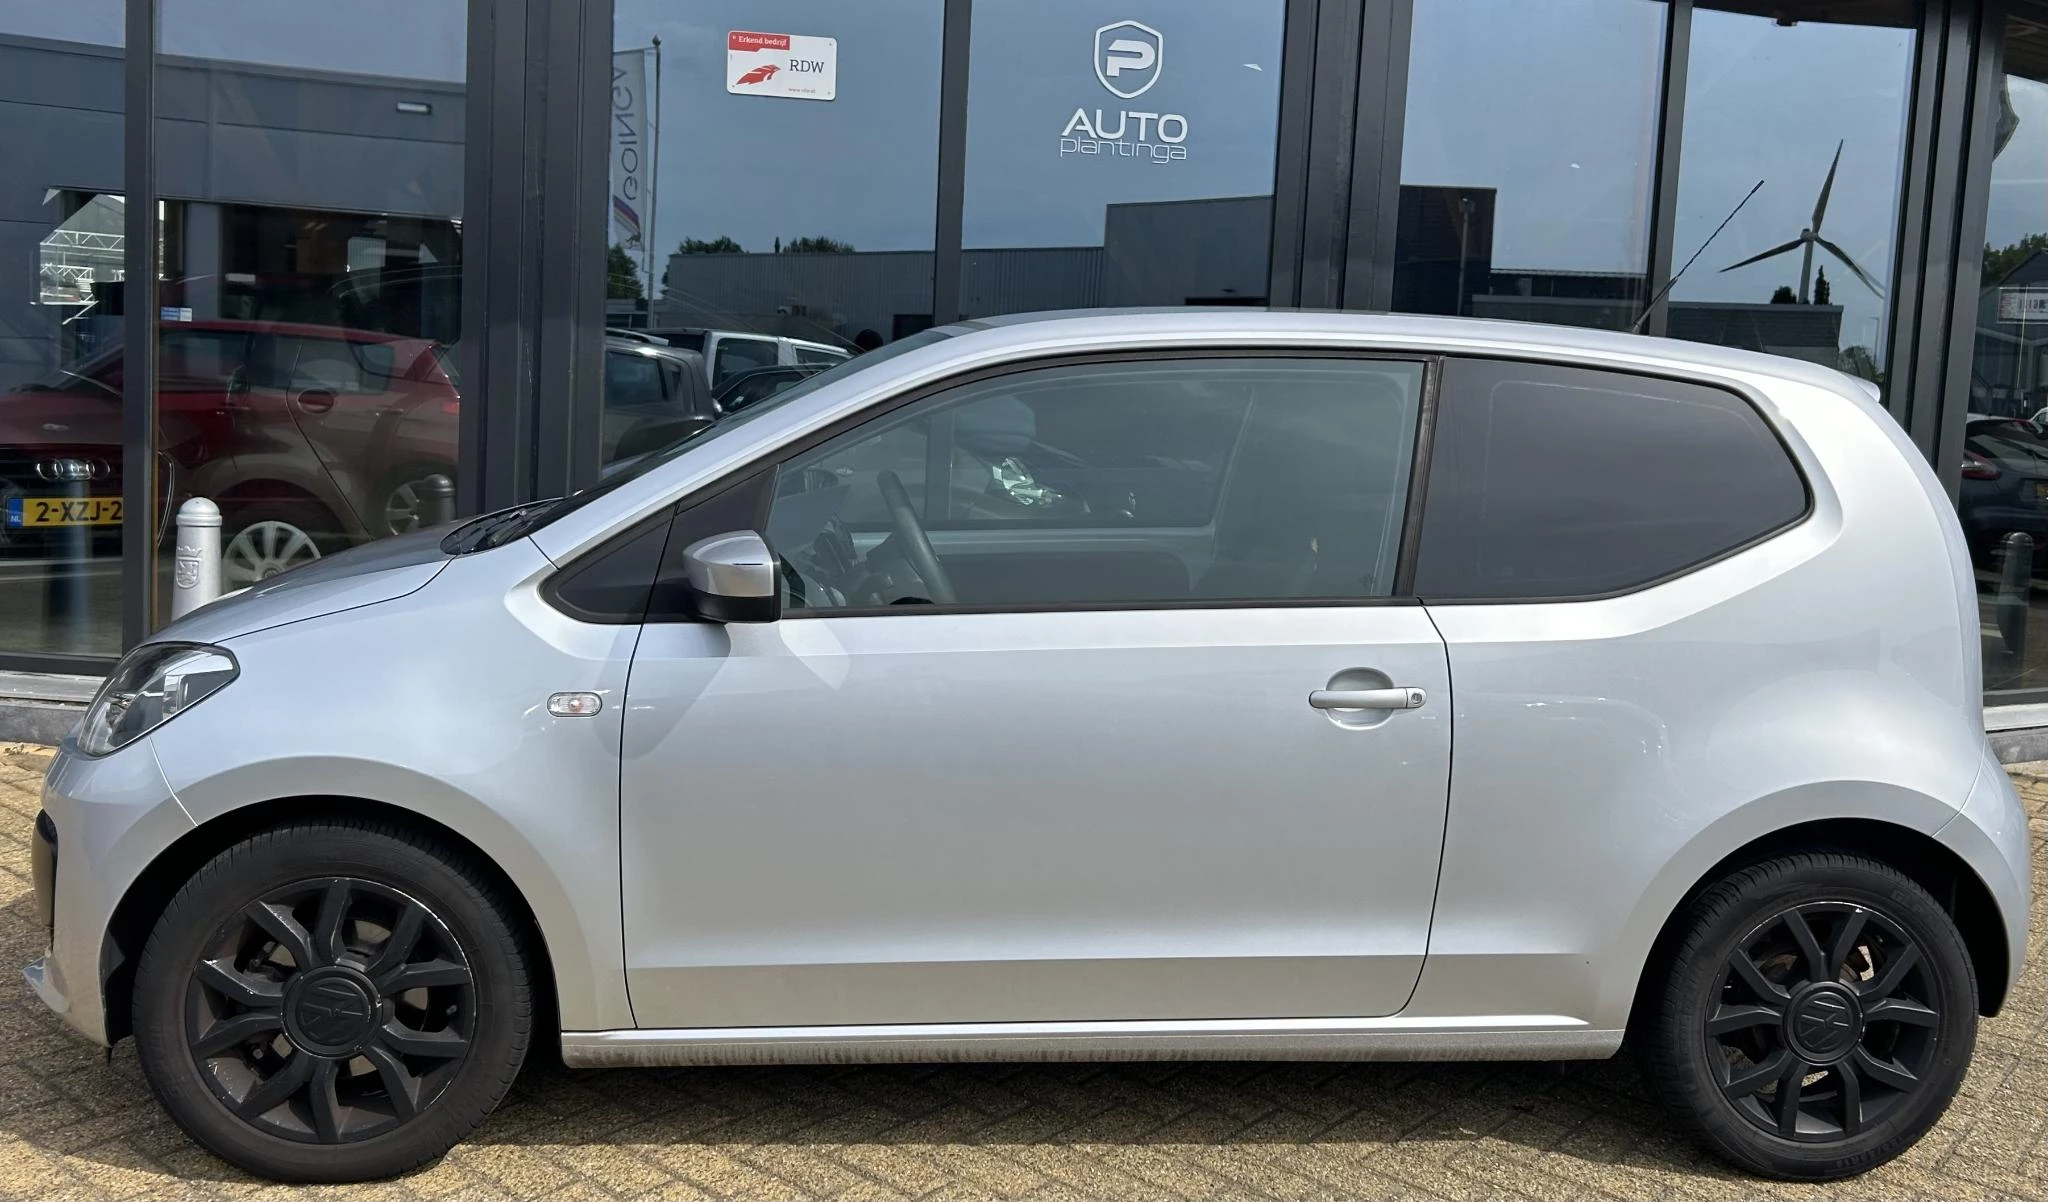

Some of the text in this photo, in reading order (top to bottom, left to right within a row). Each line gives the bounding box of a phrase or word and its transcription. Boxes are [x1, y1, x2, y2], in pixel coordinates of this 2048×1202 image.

[738, 36, 763, 45] Erkend
[789, 59, 825, 73] RDW
[1106, 39, 1156, 77] P
[1061, 107, 1188, 144] AUTO
[1059, 136, 1188, 164] plantinga
[10, 515, 22, 523] NL
[35, 501, 123, 522] 2-XZJ-2
